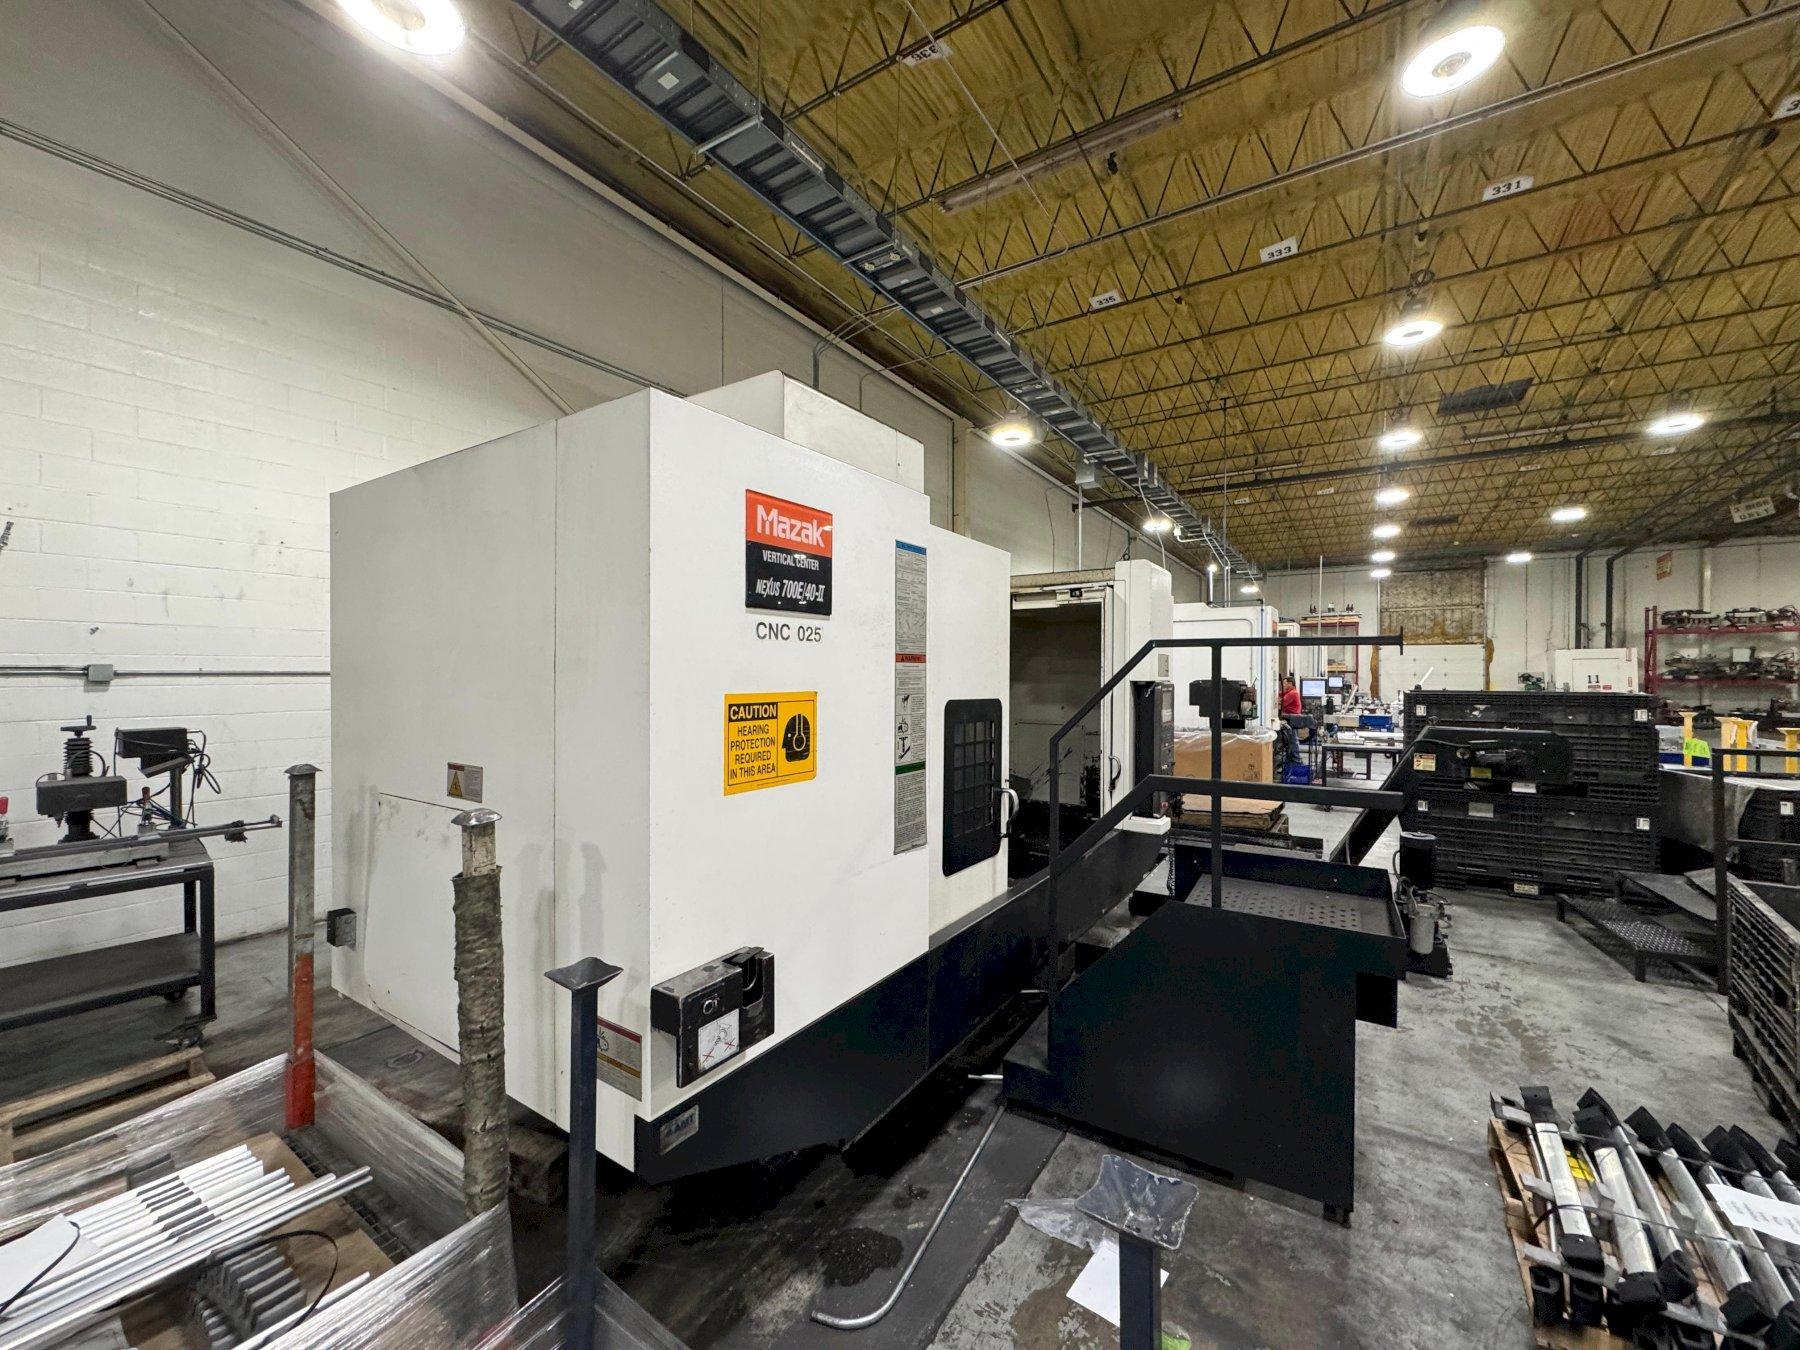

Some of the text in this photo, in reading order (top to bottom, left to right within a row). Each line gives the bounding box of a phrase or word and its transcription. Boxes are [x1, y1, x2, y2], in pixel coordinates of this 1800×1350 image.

[1492, 180, 1521, 196] 331
[1267, 246, 1292, 259] 333
[756, 504, 825, 548] Mazak
[762, 549, 820, 571] VERTICAL CENTER
[755, 577, 781, 598] NEXUS
[756, 621, 822, 643] CNC 025
[1587, 674, 1600, 684] 11
[730, 704, 777, 720] CAUTION
[737, 724, 769, 737] HEARING
[730, 737, 776, 752] PROTECTION
[735, 750, 772, 765] REQUIRED
[730, 763, 776, 780] IN THIS AREA
